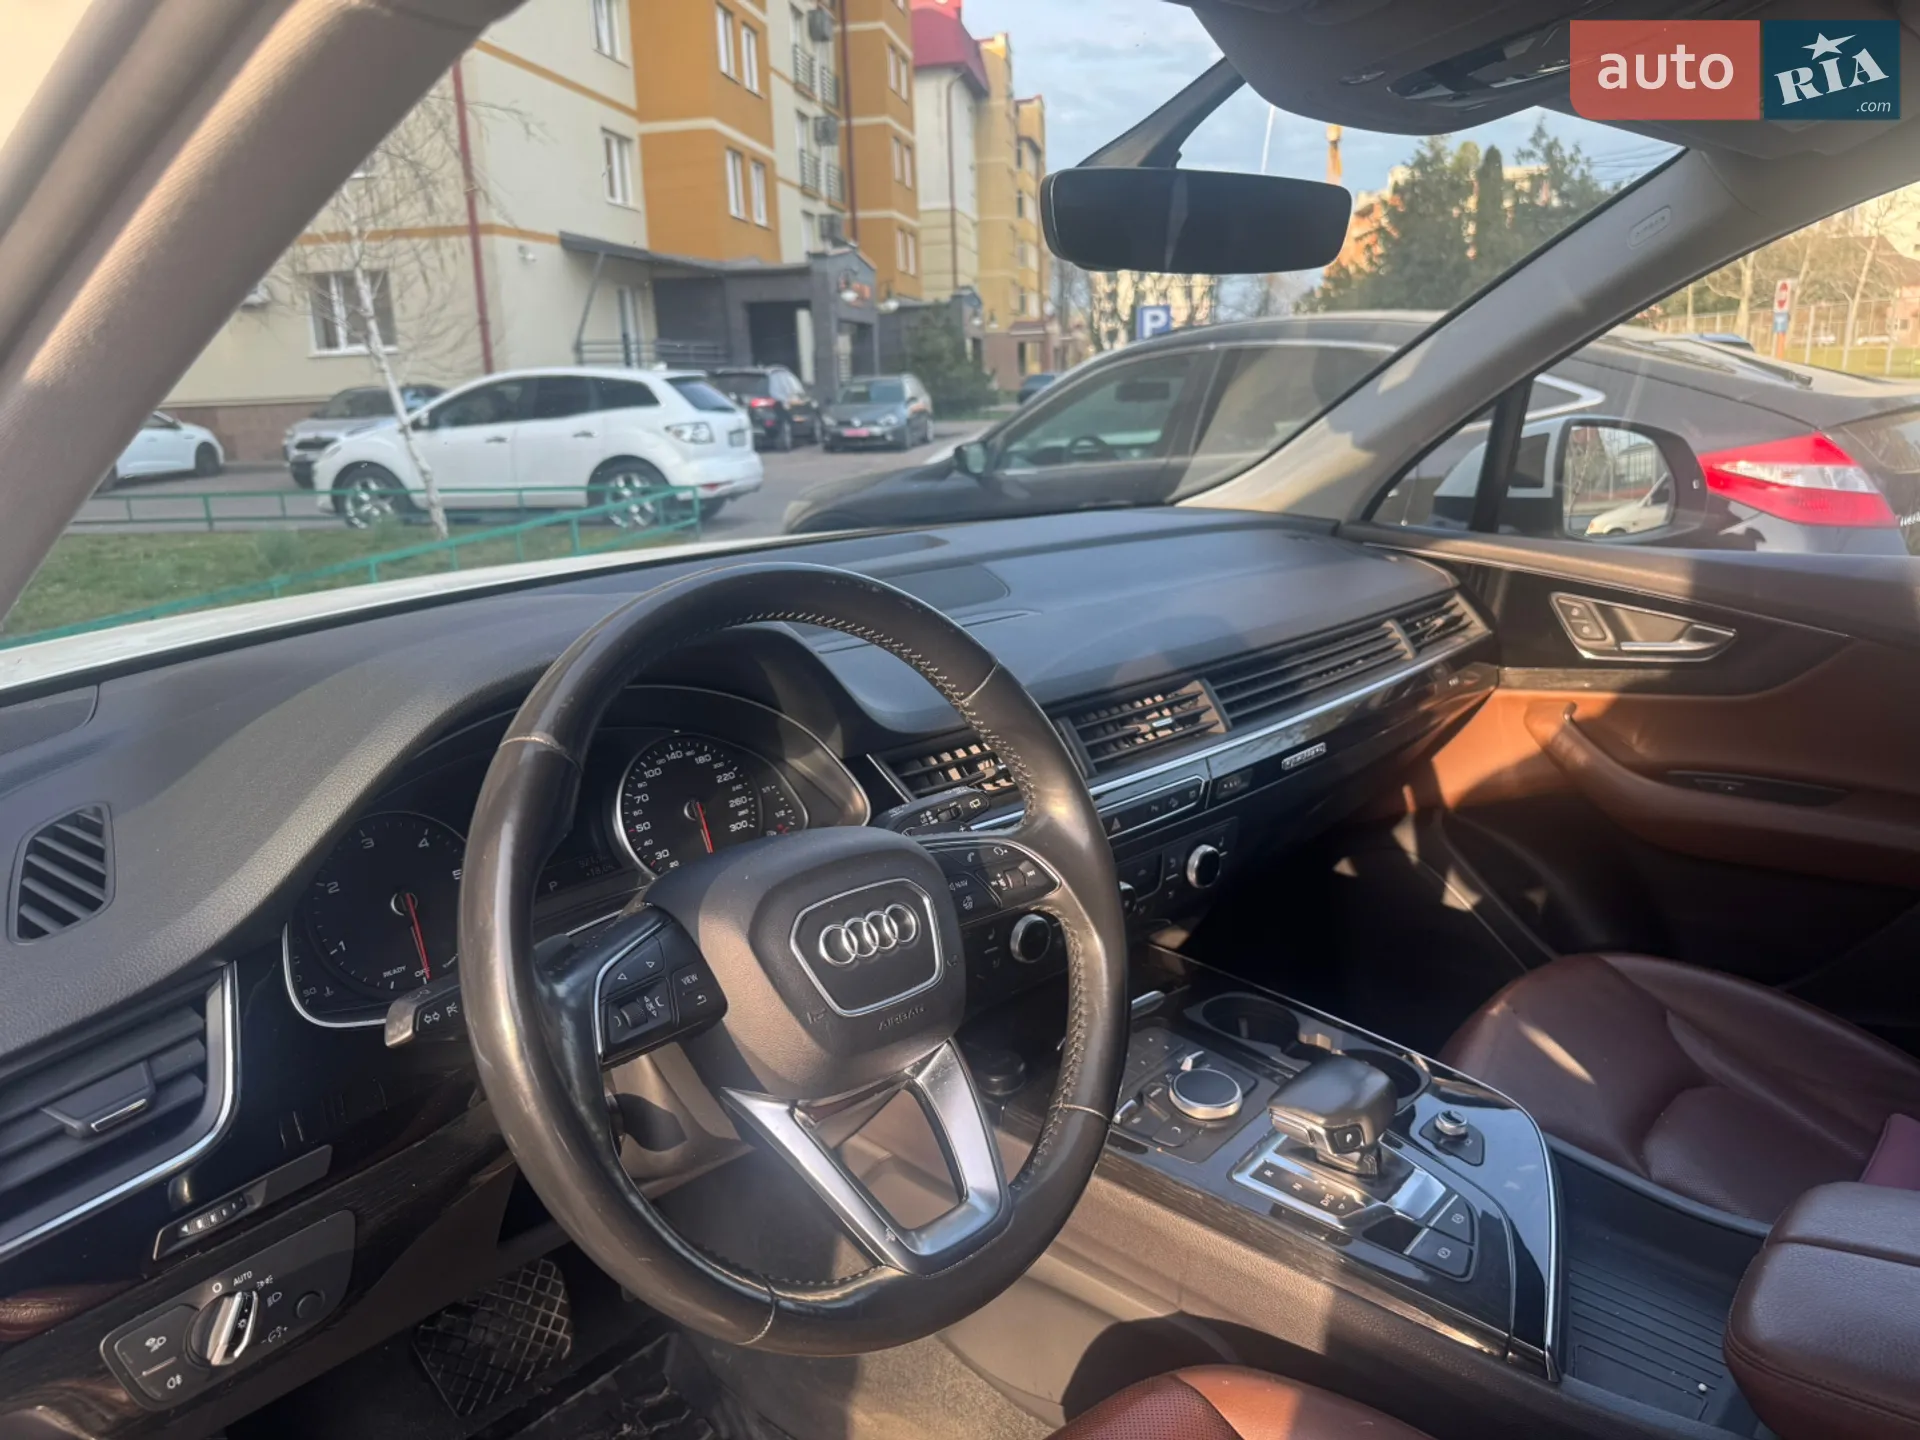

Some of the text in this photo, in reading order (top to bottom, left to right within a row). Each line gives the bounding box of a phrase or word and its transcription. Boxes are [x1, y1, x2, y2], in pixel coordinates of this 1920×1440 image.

[1143, 309, 1167, 339] P
[665, 750, 683, 761] 140
[694, 754, 712, 764] 180
[644, 767, 662, 779] 100
[716, 771, 735, 783] 220
[634, 793, 649, 805] 70
[728, 796, 747, 808] 260
[635, 821, 651, 832] 50
[729, 820, 748, 832] 300
[361, 837, 375, 849] 3
[418, 837, 430, 849] 4
[655, 849, 670, 860] 30
[326, 881, 341, 894] 2
[548, 880, 558, 892] P
[338, 940, 347, 951] 1
[681, 973, 698, 985] VIEW
[233, 1270, 252, 1287] AUTO
